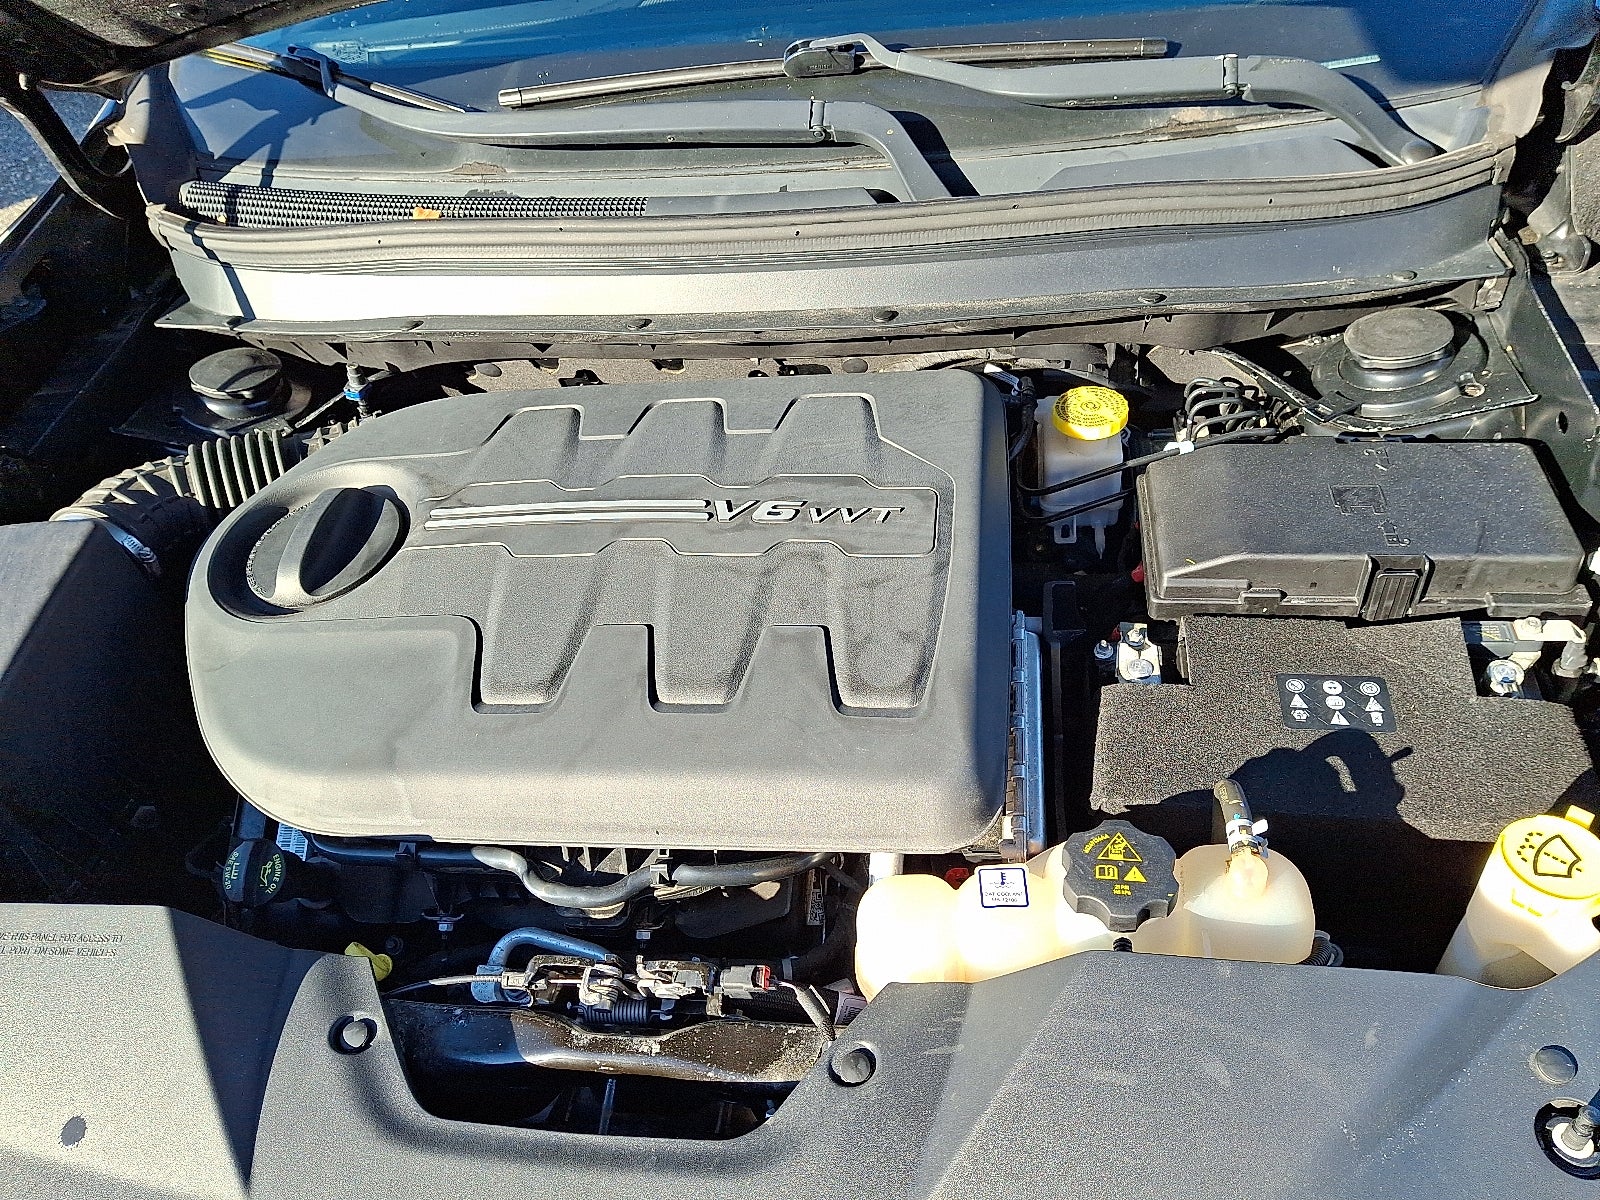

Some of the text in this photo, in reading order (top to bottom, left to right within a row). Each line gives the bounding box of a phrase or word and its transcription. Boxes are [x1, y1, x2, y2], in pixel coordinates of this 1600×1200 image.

[714, 499, 906, 524] V6 VVT
[264, 853, 283, 894] ENGINE OIL
[11, 932, 30, 941] THIS
[31, 932, 57, 942] PANEL
[59, 933, 77, 942] FOR
[79, 934, 111, 943] ACCESS
[111, 935, 124, 943] TO
[34, 946, 48, 955] ON
[49, 947, 75, 956] SOME
[76, 948, 118, 957] VEHICLES
